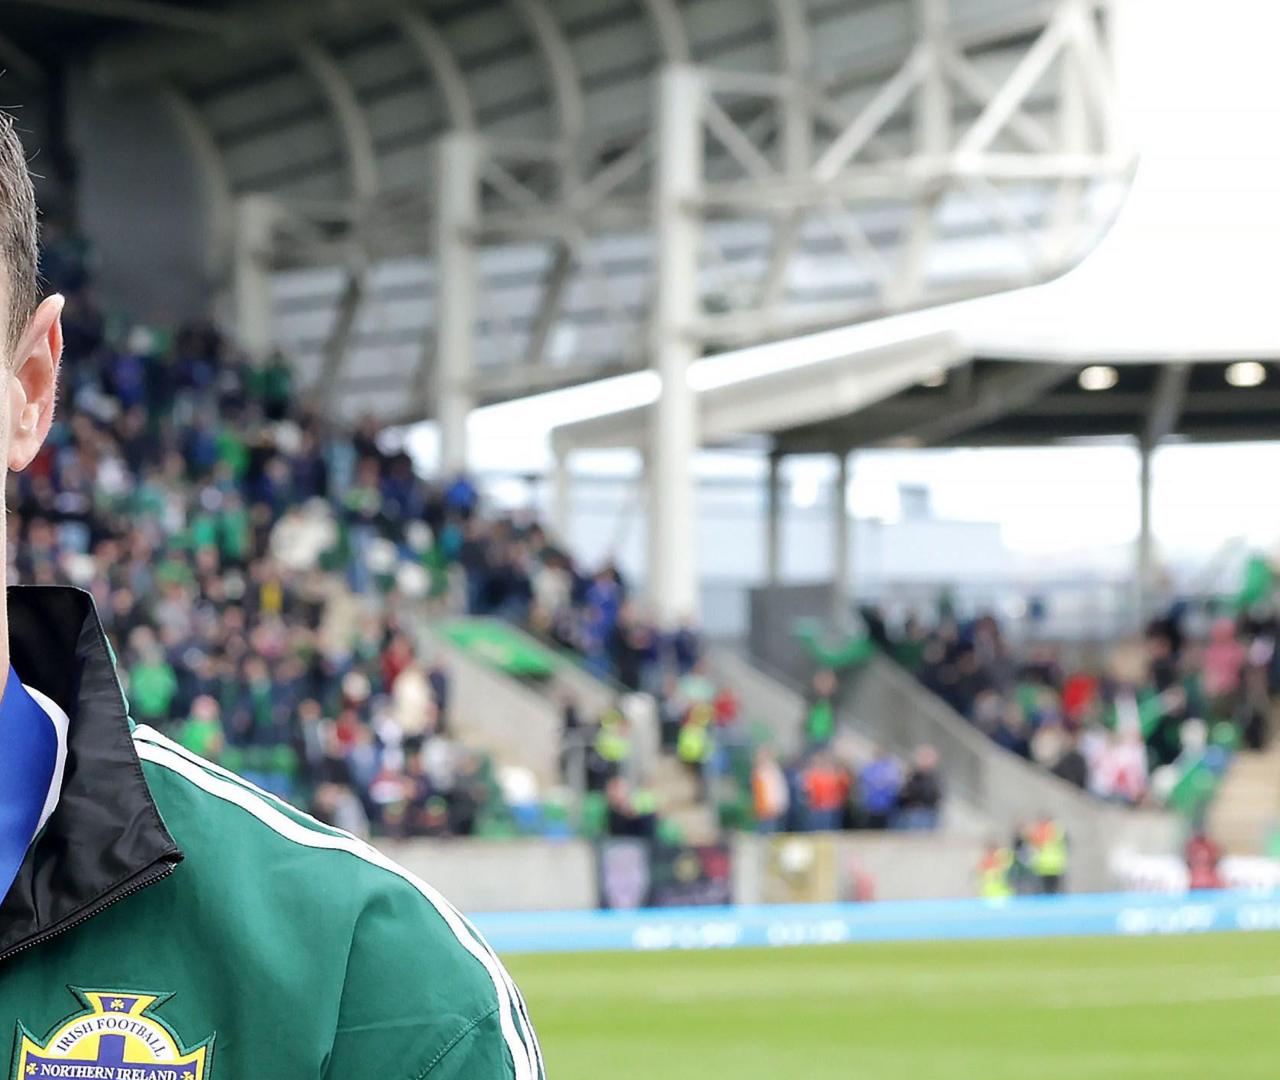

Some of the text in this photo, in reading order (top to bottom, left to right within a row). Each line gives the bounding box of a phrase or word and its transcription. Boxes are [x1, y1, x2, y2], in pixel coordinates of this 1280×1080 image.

[56, 1017, 166, 1057] IRISH FOOTBALL
[40, 1063, 115, 1080] NORTHERN
